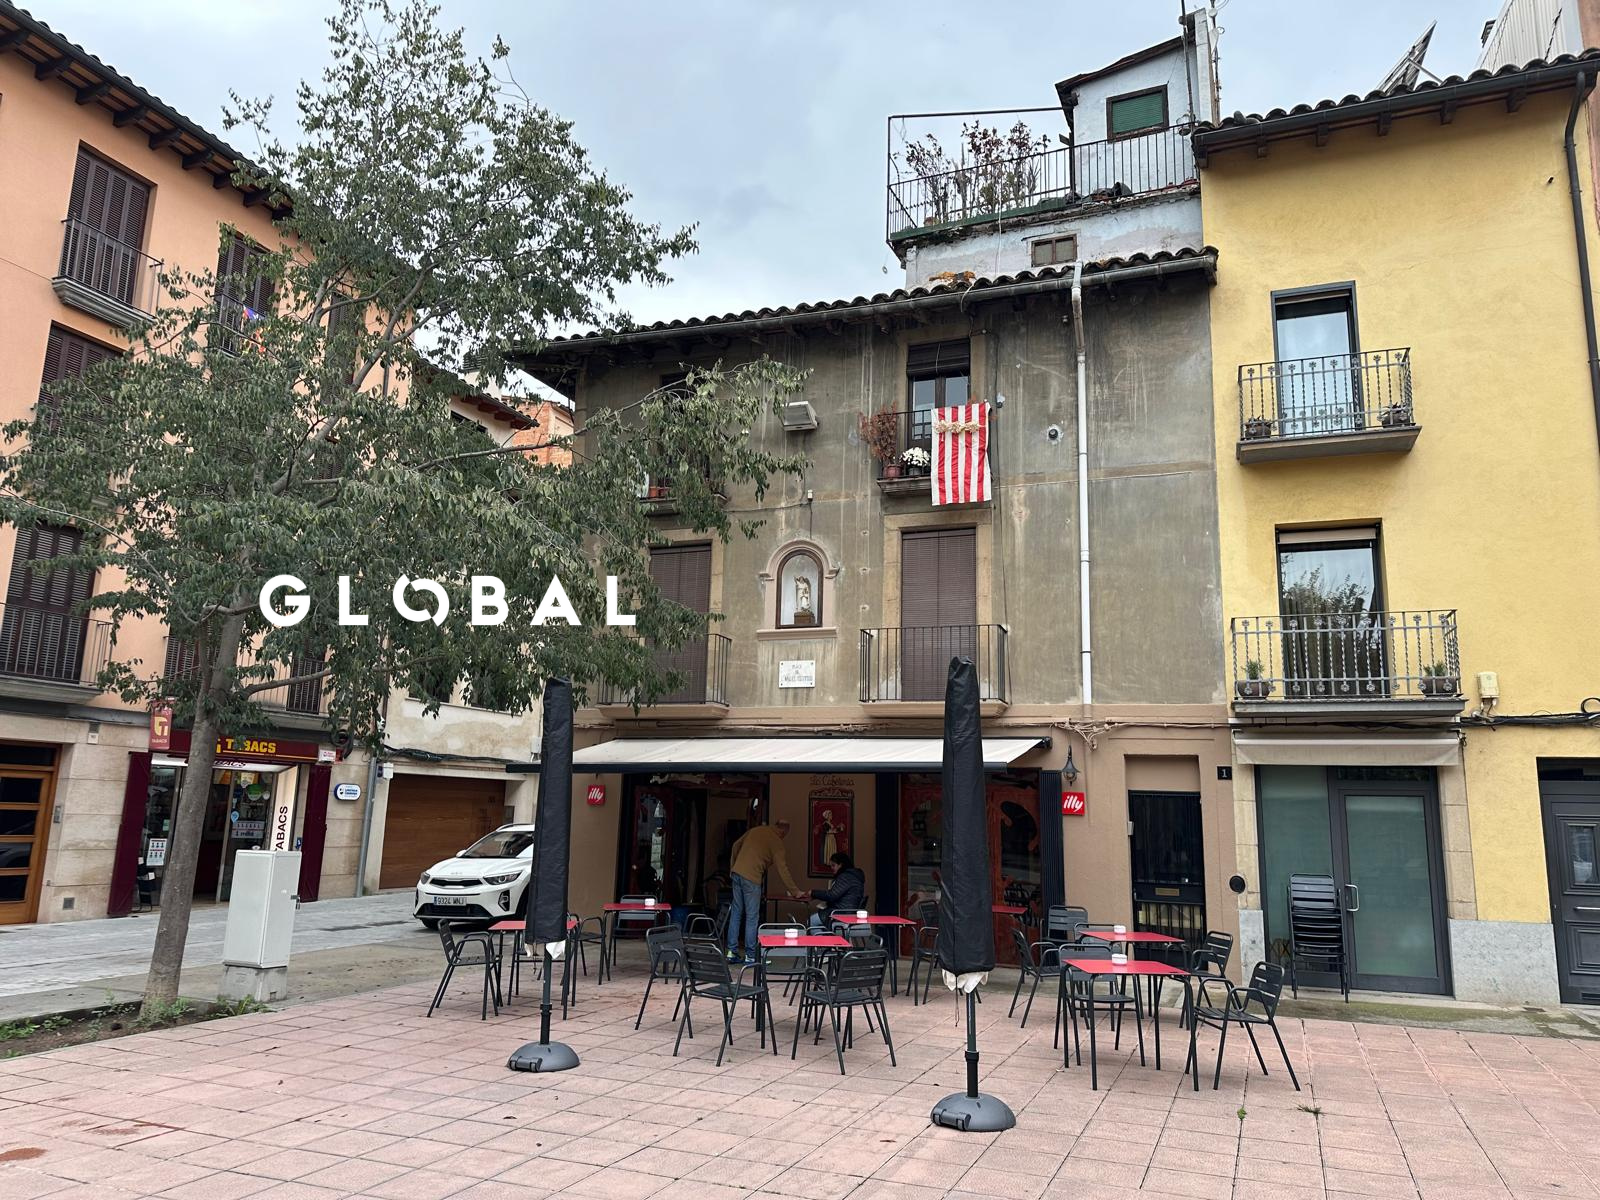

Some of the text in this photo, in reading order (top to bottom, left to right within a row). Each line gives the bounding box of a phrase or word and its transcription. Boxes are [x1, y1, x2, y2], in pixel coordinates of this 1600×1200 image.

[225, 738, 277, 754] TBACS
[1222, 768, 1228, 778] 1
[588, 787, 604, 803] illy
[1063, 795, 1084, 813] illy
